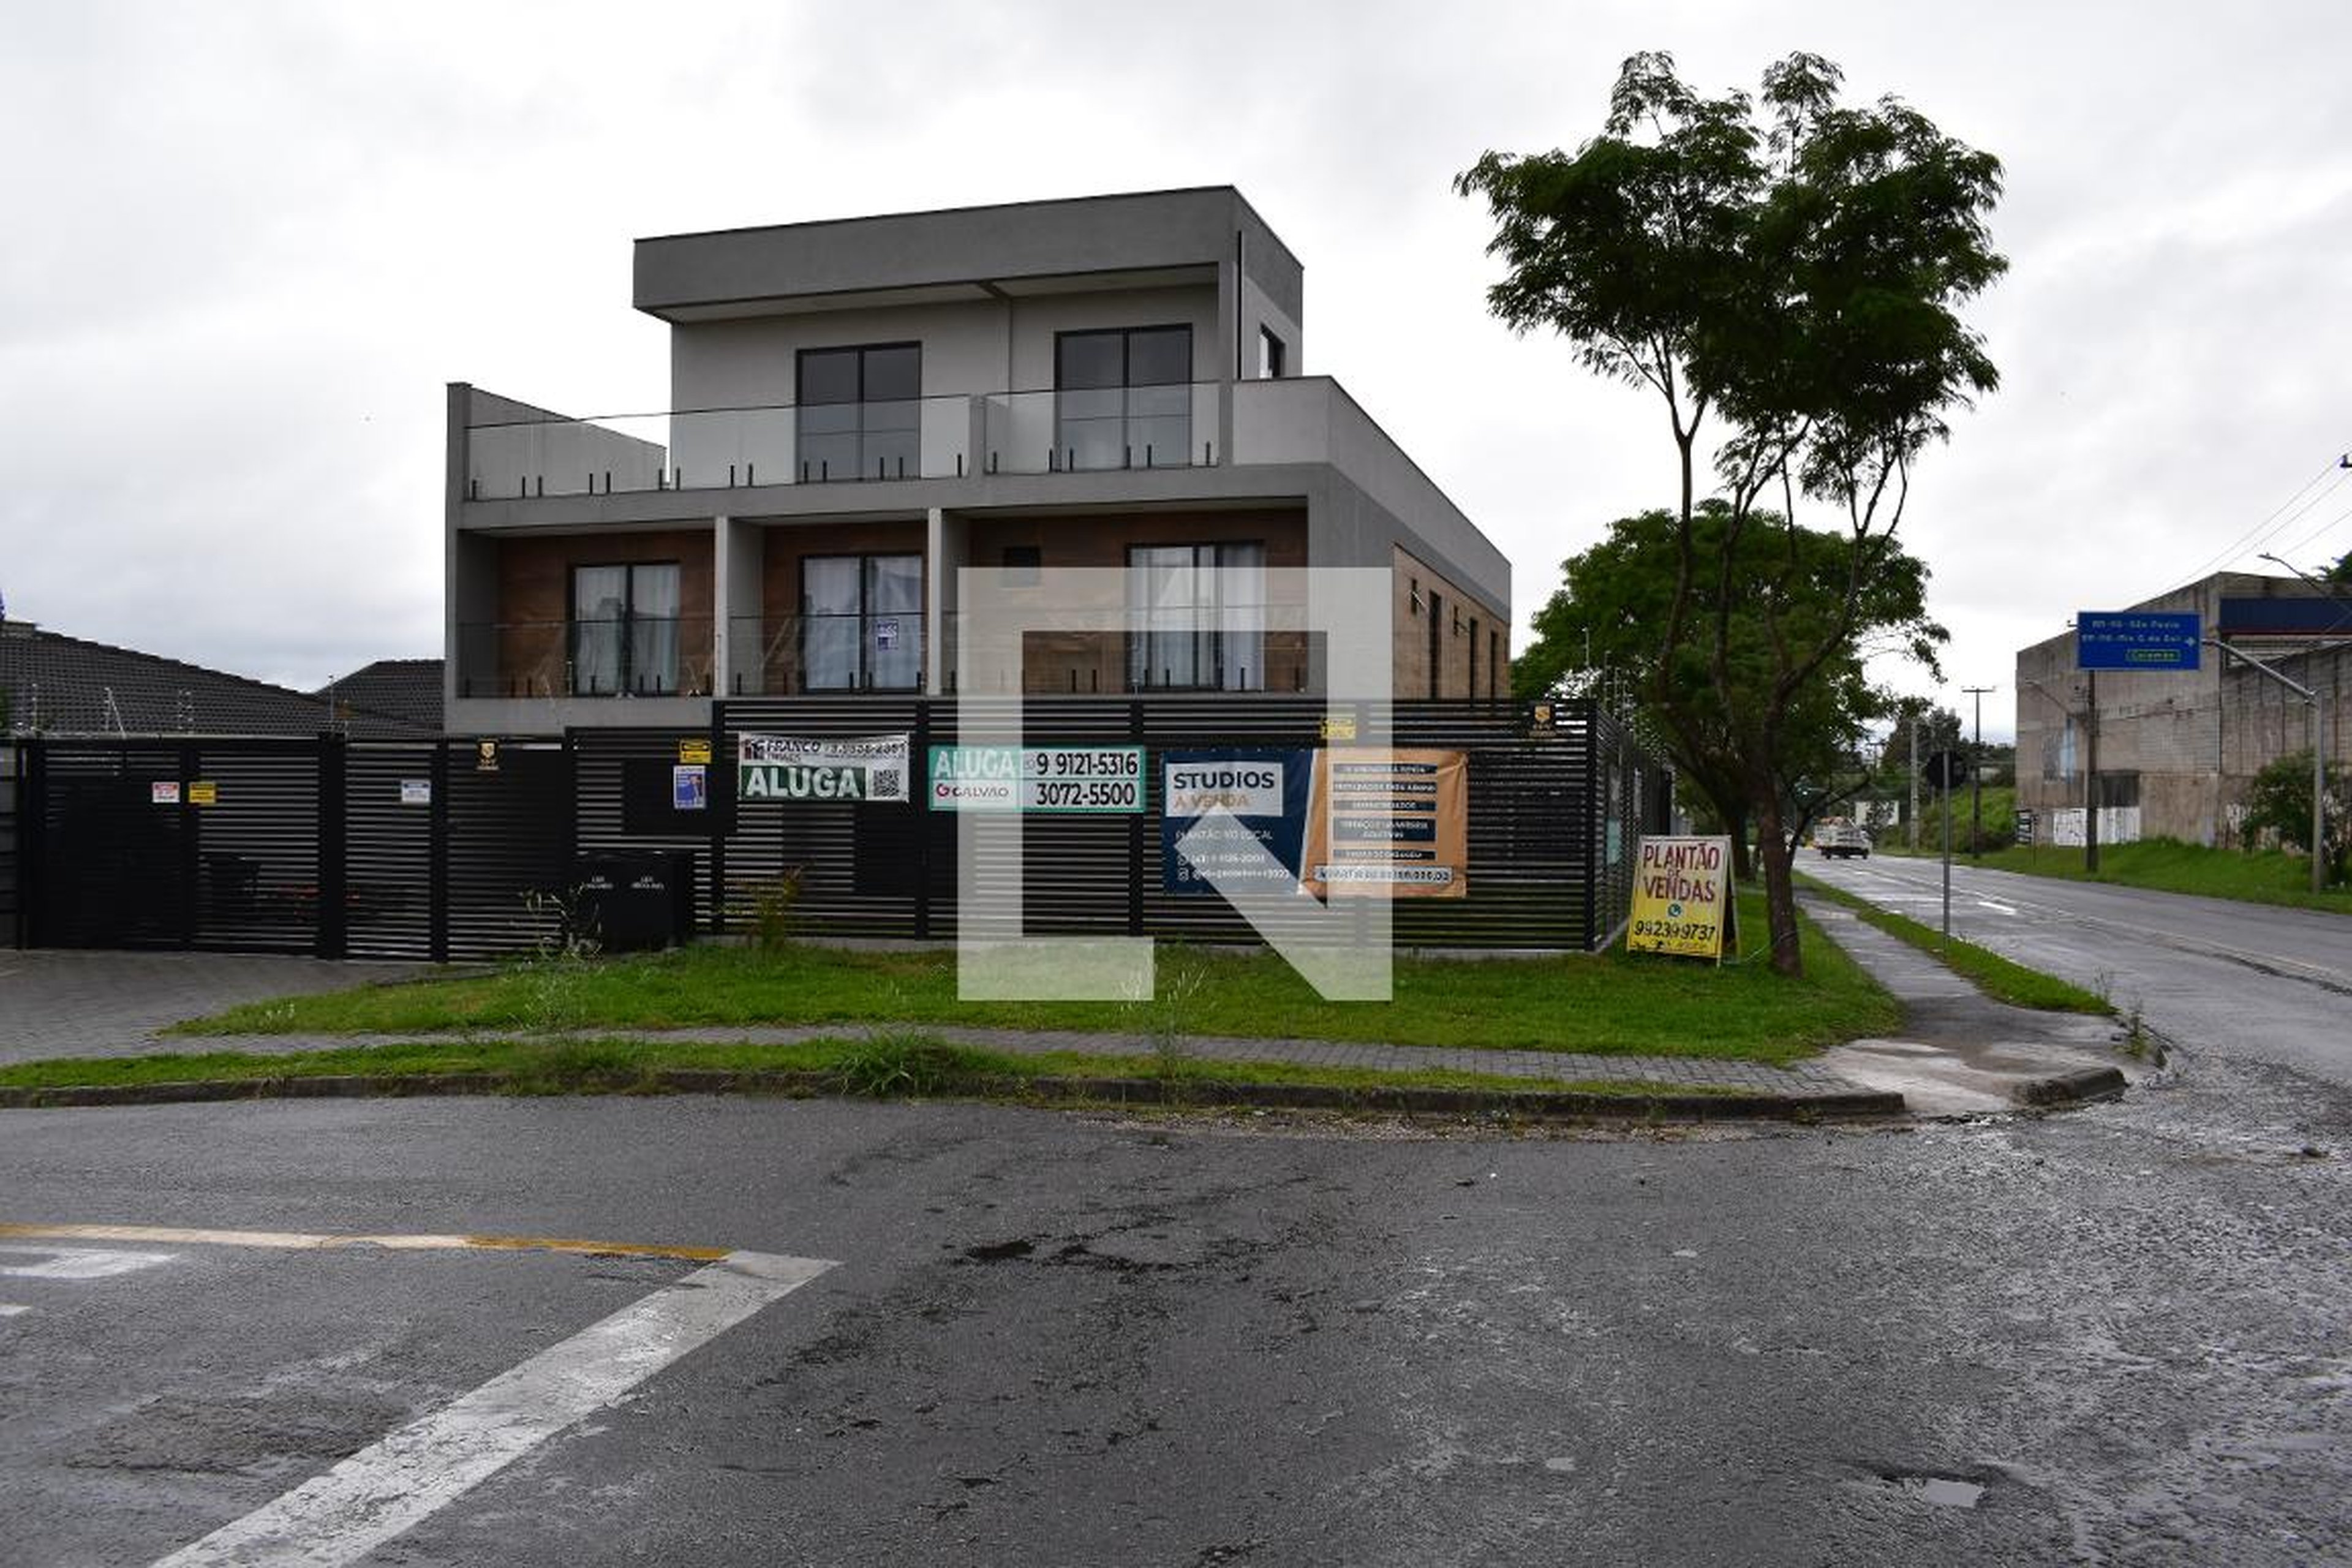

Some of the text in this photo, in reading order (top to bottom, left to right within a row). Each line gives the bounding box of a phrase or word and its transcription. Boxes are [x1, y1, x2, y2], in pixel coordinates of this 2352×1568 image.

[767, 739, 821, 752] FRANCO
[935, 749, 1016, 778] ALUGA
[1036, 753, 1137, 775] 9 9121-5316
[746, 767, 860, 797] ALUGA
[1173, 771, 1275, 790] STUDIOS
[1036, 783, 1136, 805] 3072-5500
[1191, 793, 1248, 808] VENDA
[1643, 843, 1719, 870] PLANTÃO
[1643, 875, 1715, 902] VENDAS
[1634, 920, 1715, 940] 992399737
